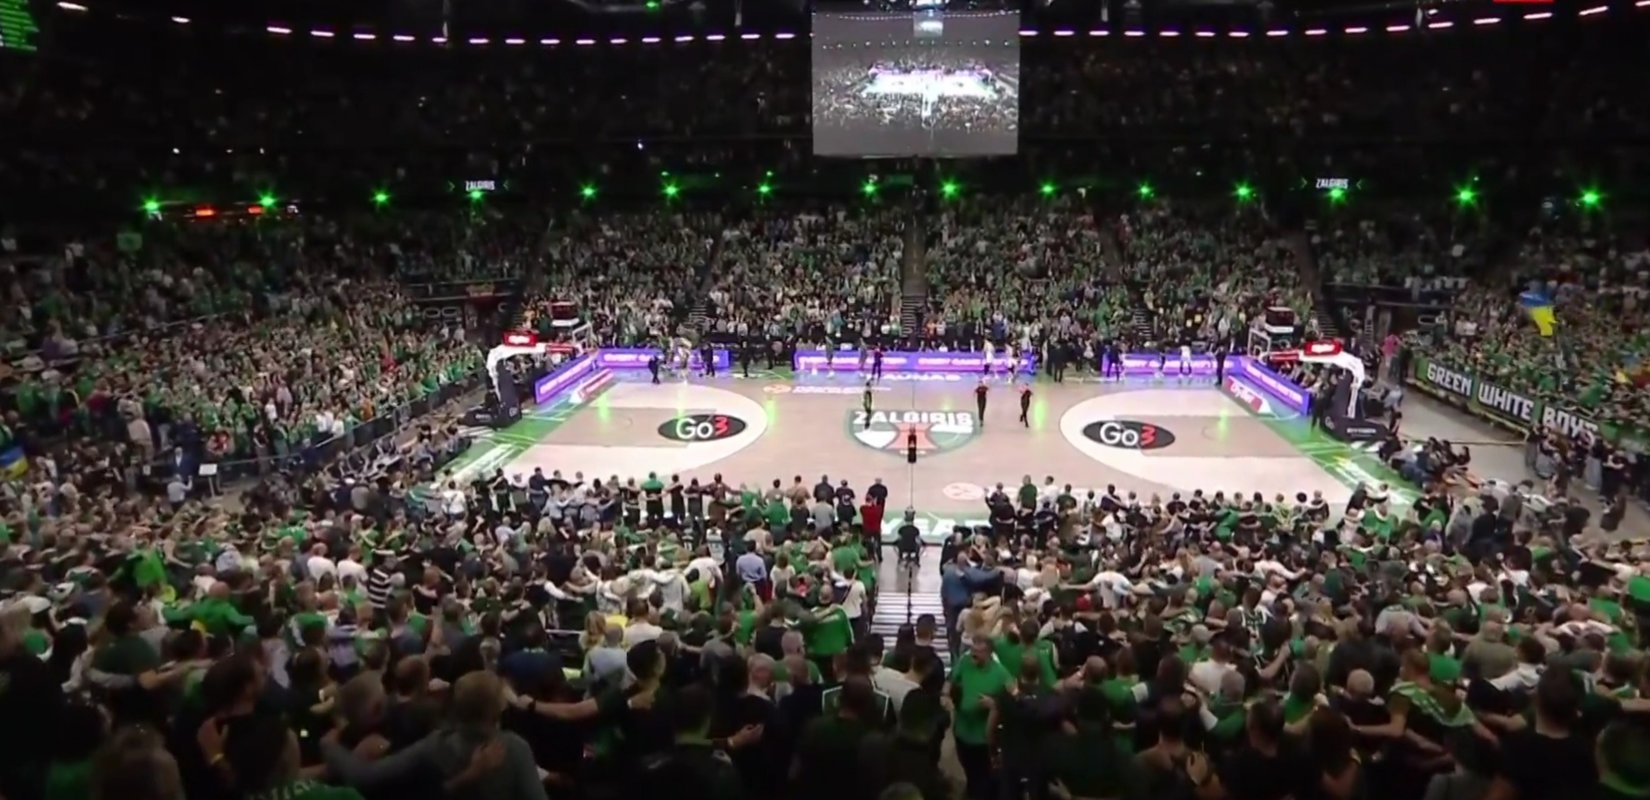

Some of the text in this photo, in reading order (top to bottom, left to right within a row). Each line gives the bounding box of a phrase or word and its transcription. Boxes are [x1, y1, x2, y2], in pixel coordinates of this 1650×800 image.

[1427, 362, 1473, 397] GREEN
[1478, 381, 1534, 422] WHITE
[674, 416, 729, 440] Go3
[1099, 420, 1157, 446] Go3
